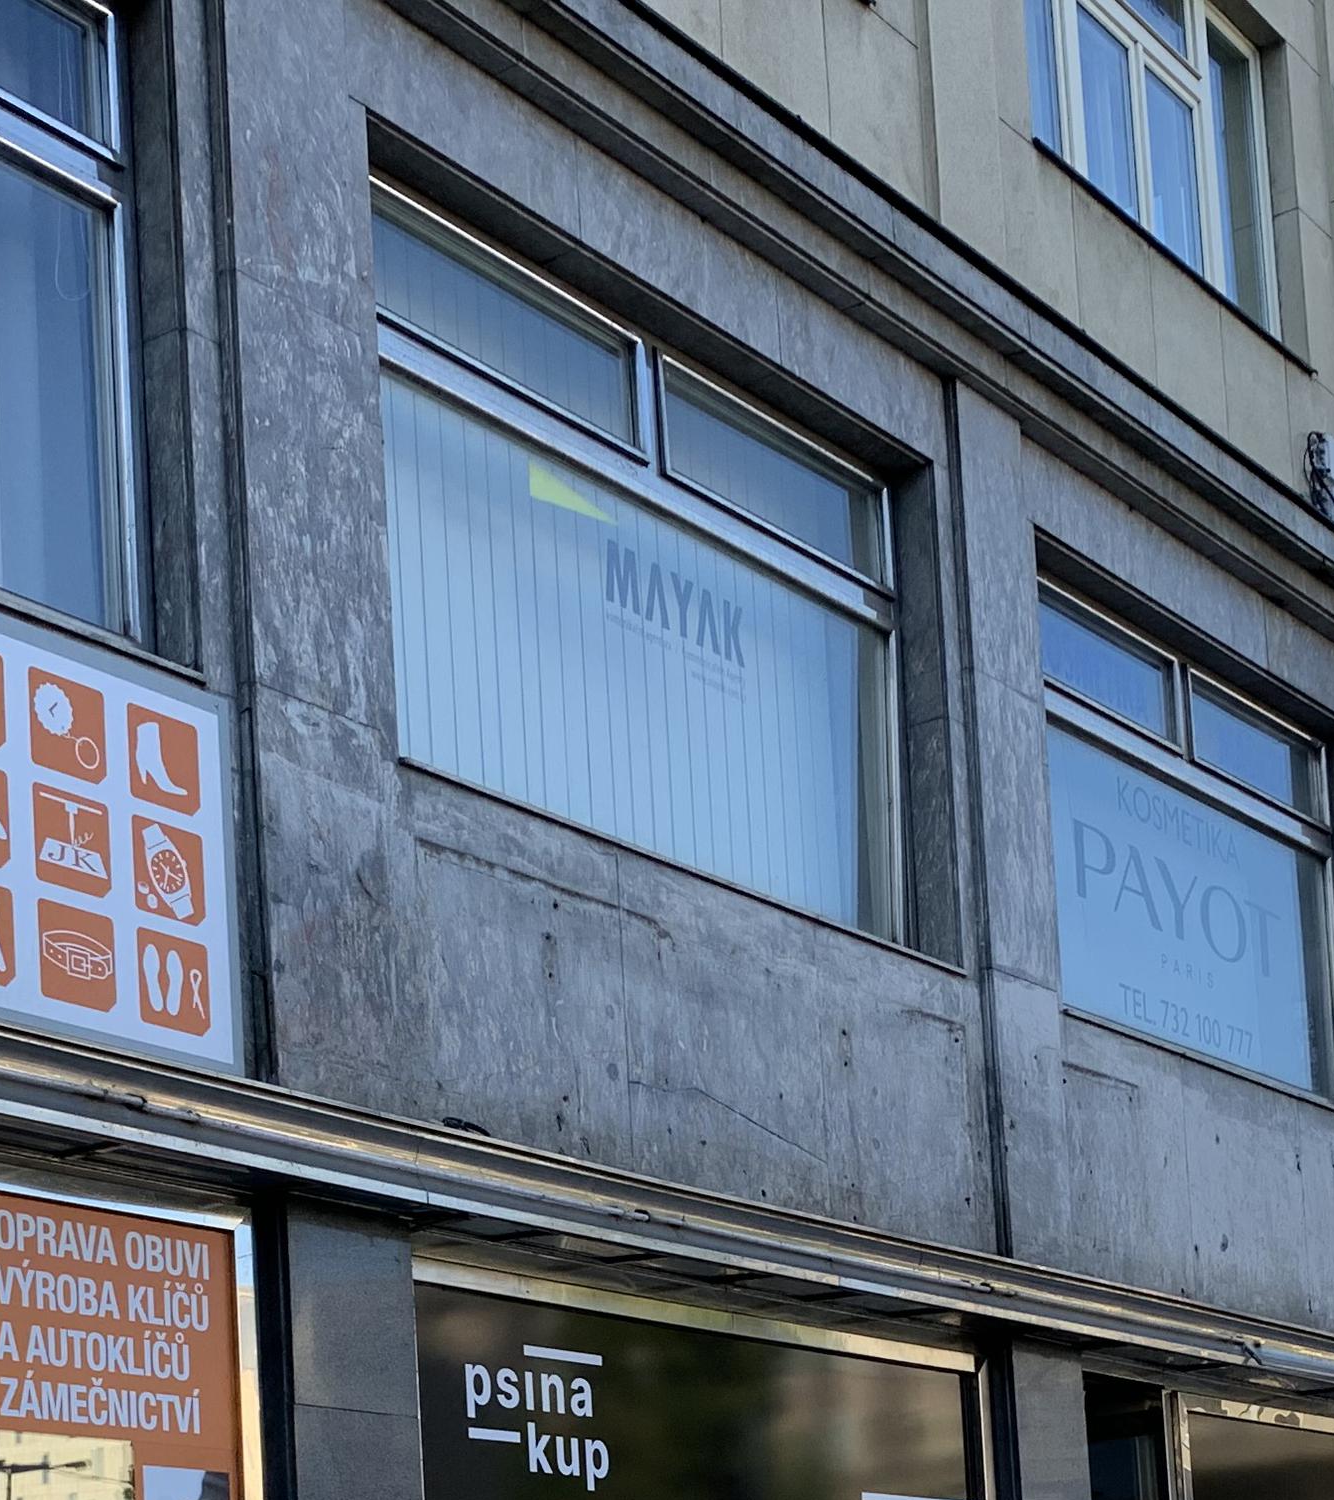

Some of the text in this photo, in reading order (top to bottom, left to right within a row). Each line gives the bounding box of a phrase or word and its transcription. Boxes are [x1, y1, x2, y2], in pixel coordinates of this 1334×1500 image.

[605, 538, 745, 668] MAYAK
[1117, 775, 1241, 870] KOSMETIKA
[1072, 817, 1282, 978] PAYOT
[1161, 953, 1215, 988] PARIS
[1118, 982, 1253, 1059] TEL. 732 100 777
[125, 1231, 210, 1281] OBUVI
[127, 1280, 210, 1332] KLÍČŮ
[26, 1325, 190, 1382] AUTOKLÍČŮ
[0, 1370, 201, 1435] ZÁMEČNICTVÍ
[526, 1421, 610, 1492] kup
